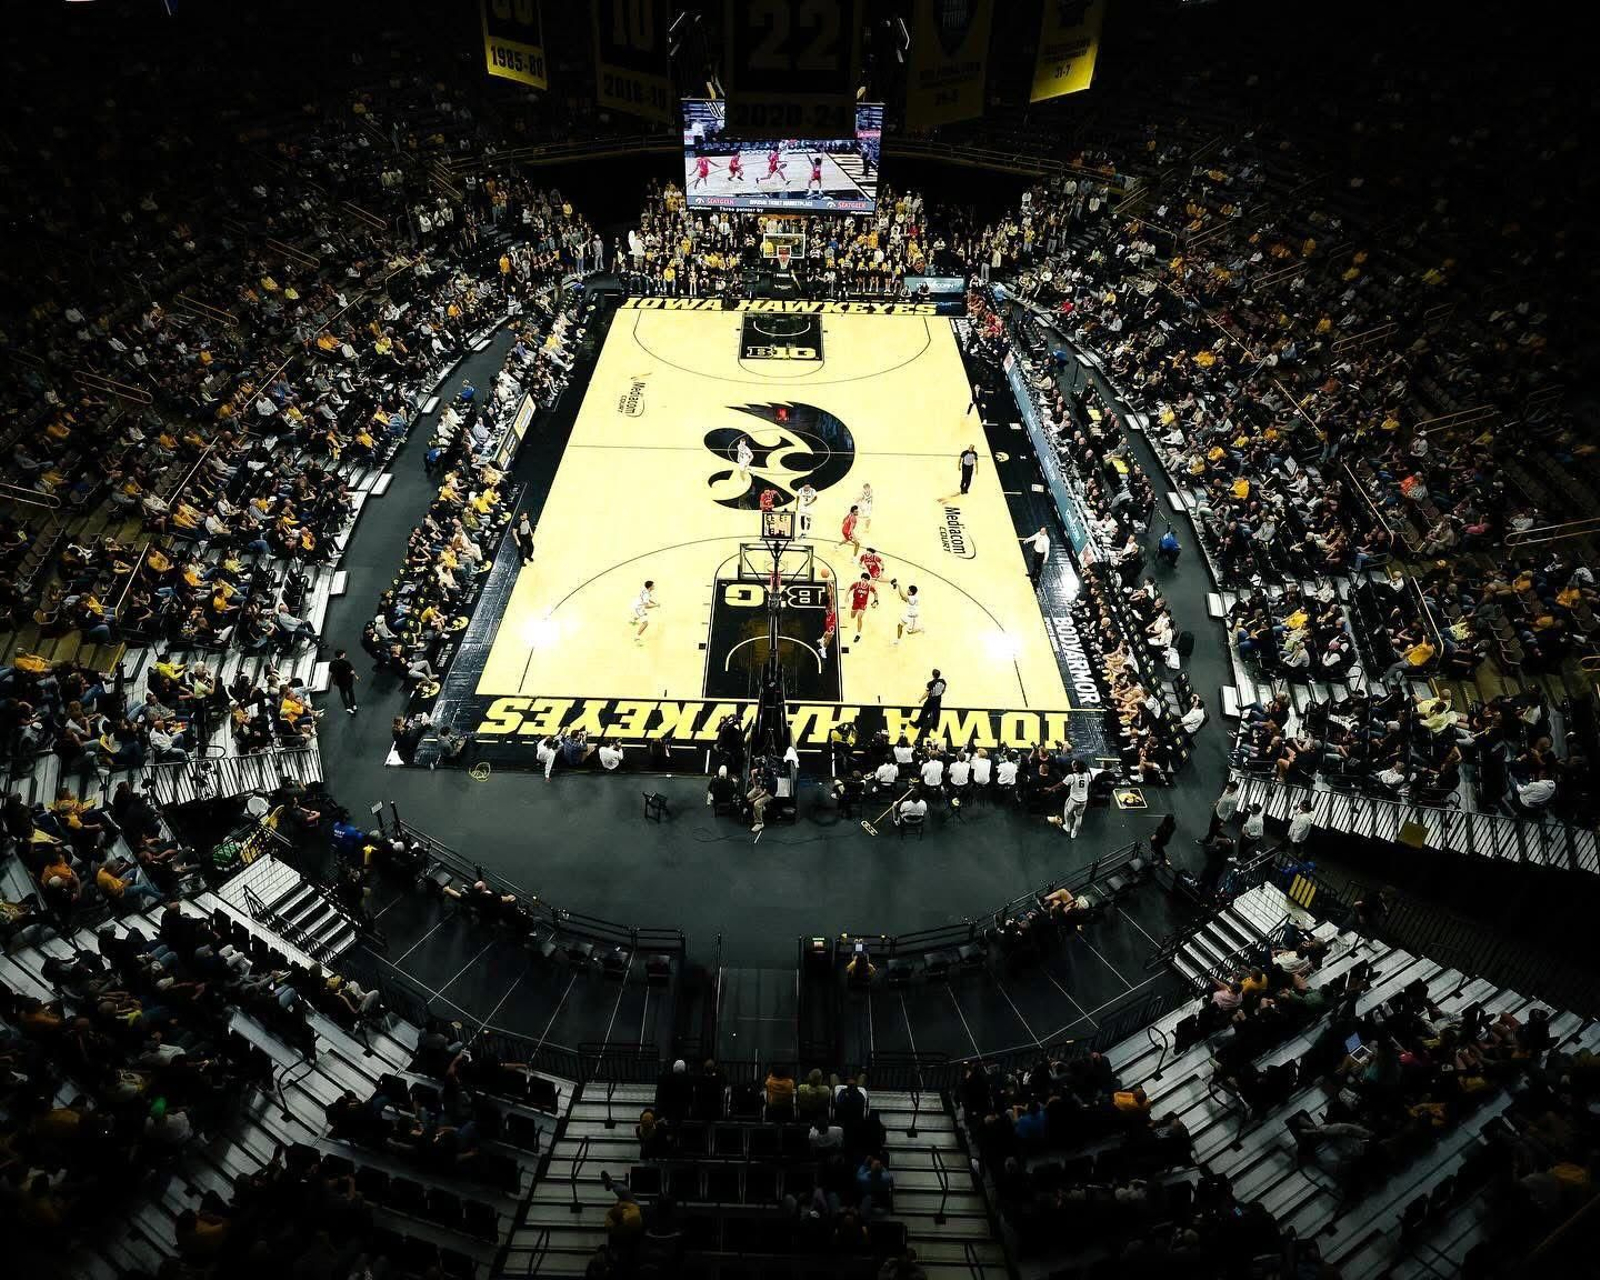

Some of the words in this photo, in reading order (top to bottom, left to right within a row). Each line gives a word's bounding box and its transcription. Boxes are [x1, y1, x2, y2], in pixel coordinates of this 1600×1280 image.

[747, 0, 840, 71] 22
[837, 201, 867, 209] SEATGEEK
[620, 297, 723, 310] IOWA
[734, 299, 937, 315] HAWKEYES
[939, 526, 951, 553] COURT
[944, 506, 966, 554] Mediacom
[1052, 617, 1101, 704] BODYARMOR
[883, 706, 1069, 750] IOWA
[1078, 779, 1086, 789] 6
